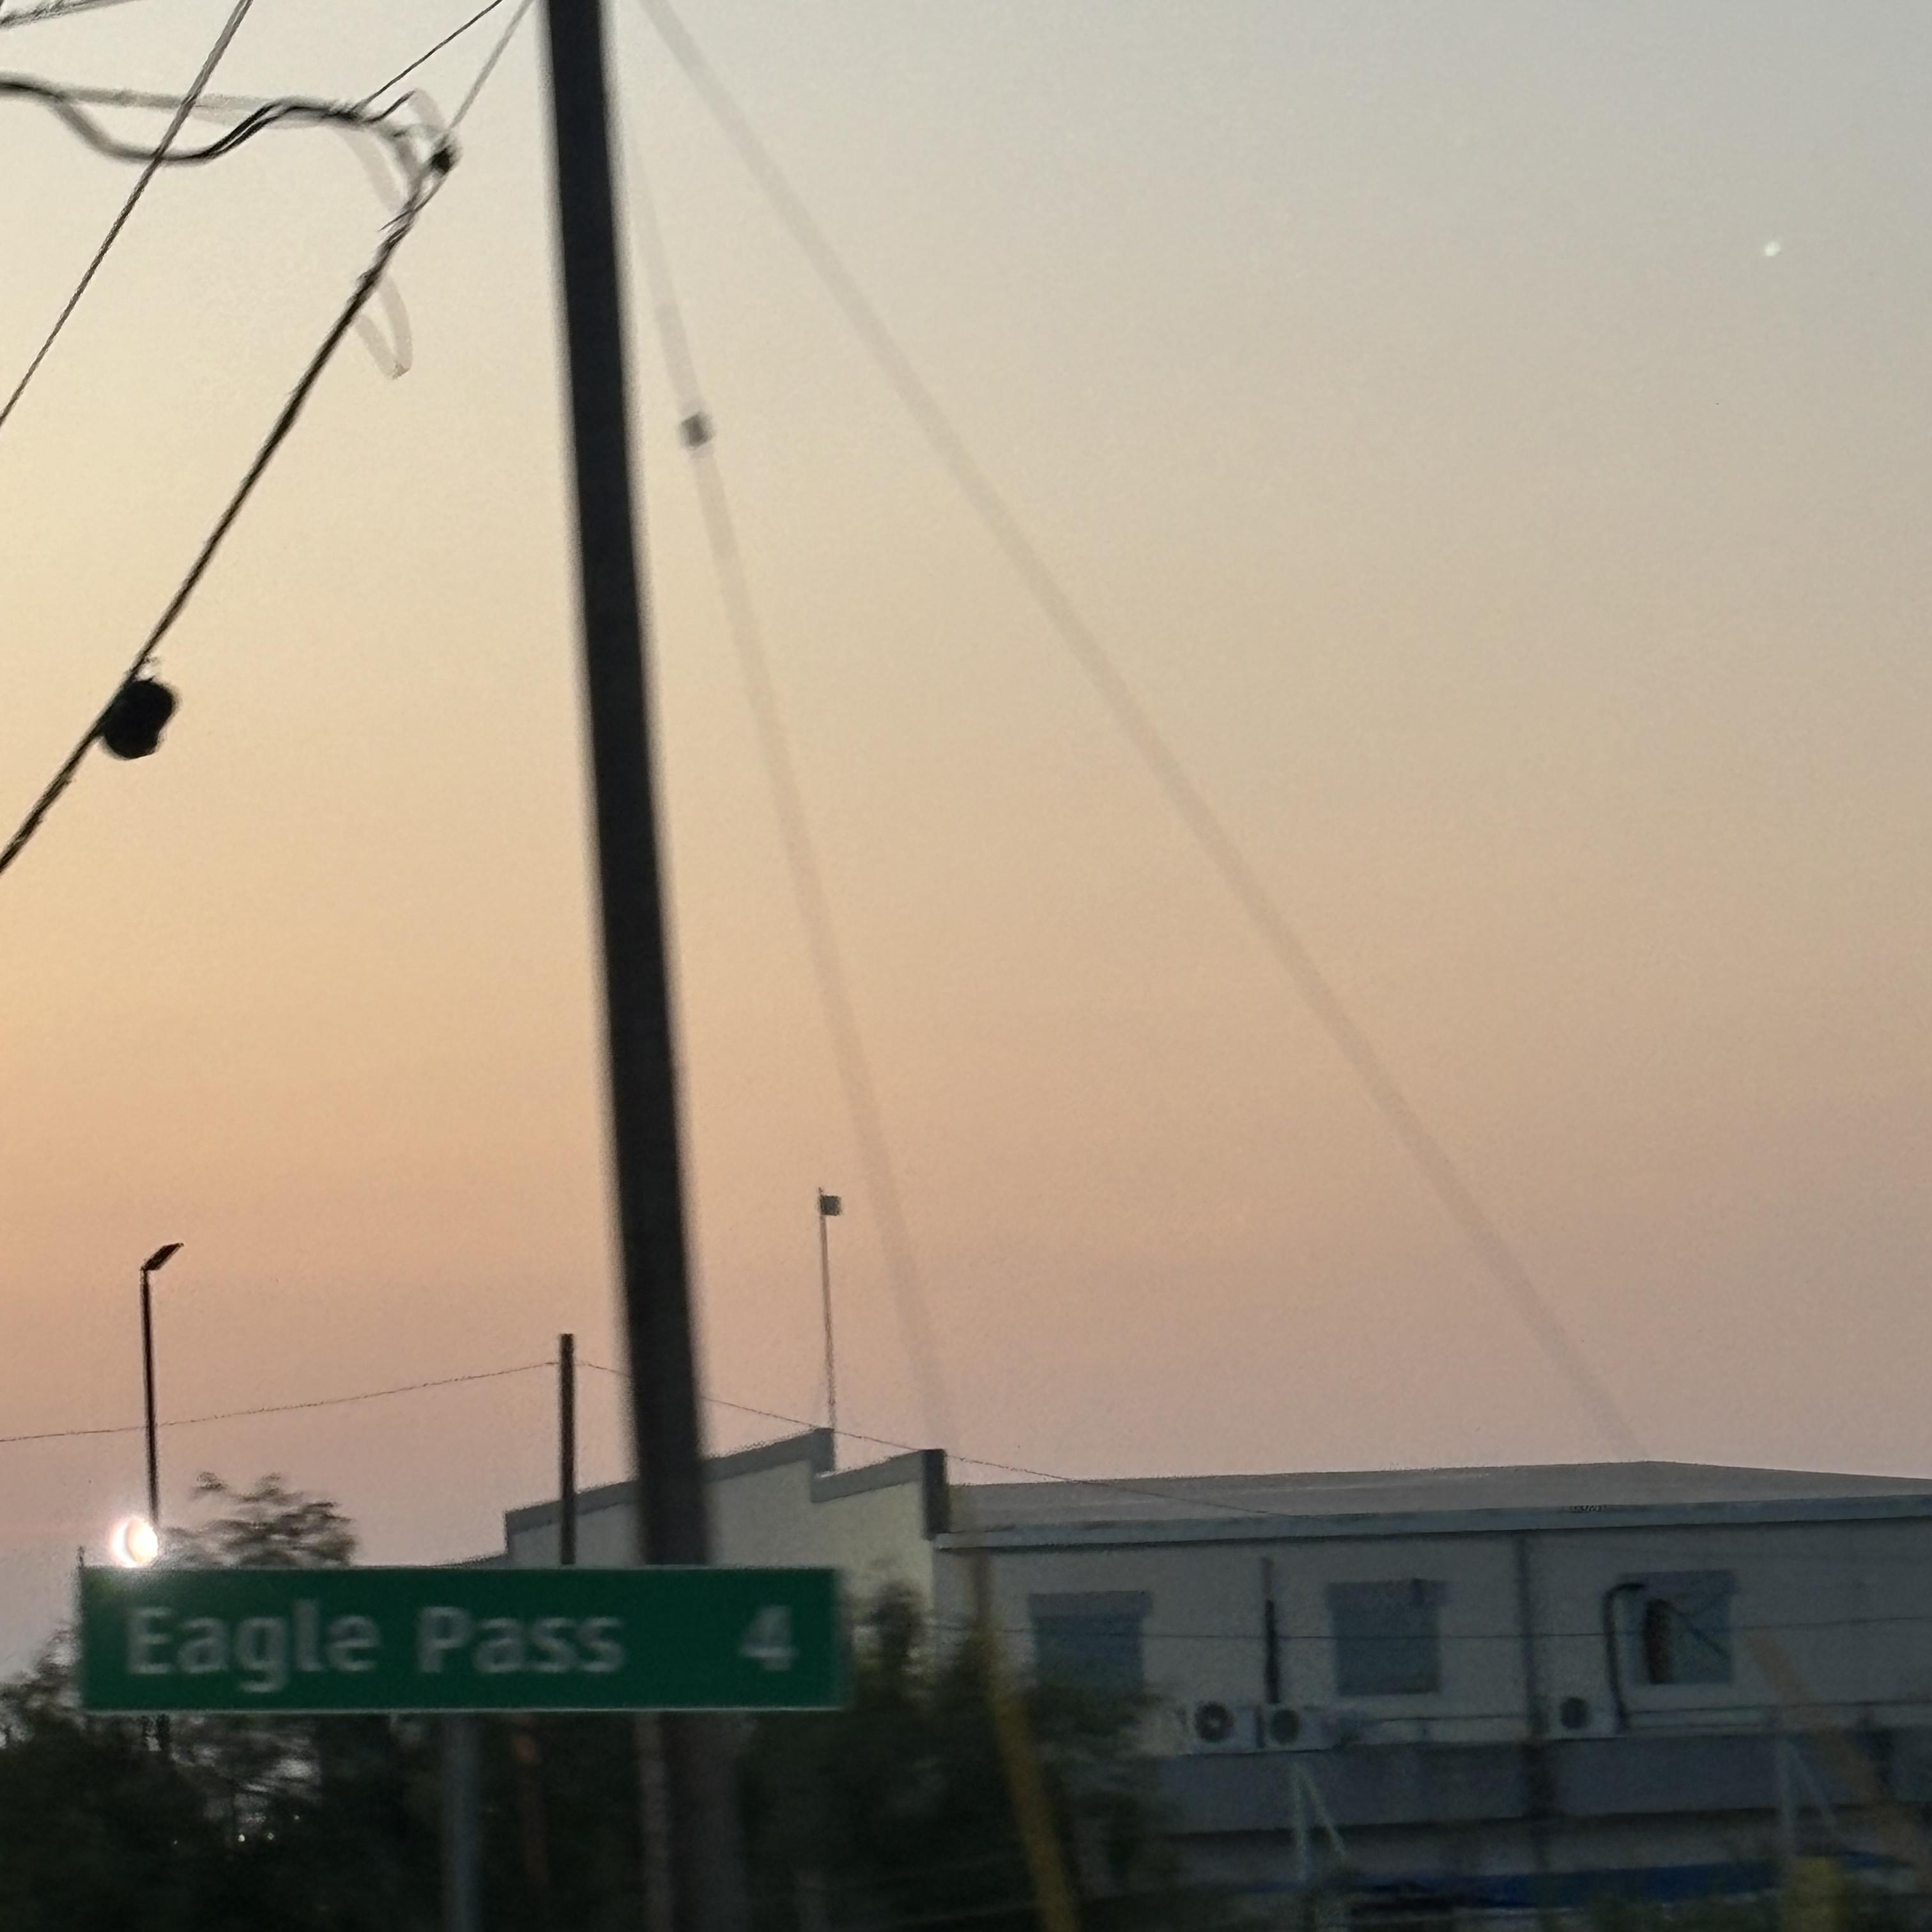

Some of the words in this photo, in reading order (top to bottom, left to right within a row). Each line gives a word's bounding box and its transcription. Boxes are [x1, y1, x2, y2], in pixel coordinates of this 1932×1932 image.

[126, 1599, 381, 1693] Eagle
[417, 1606, 625, 1674] Pass
[739, 1604, 799, 1671] 4
